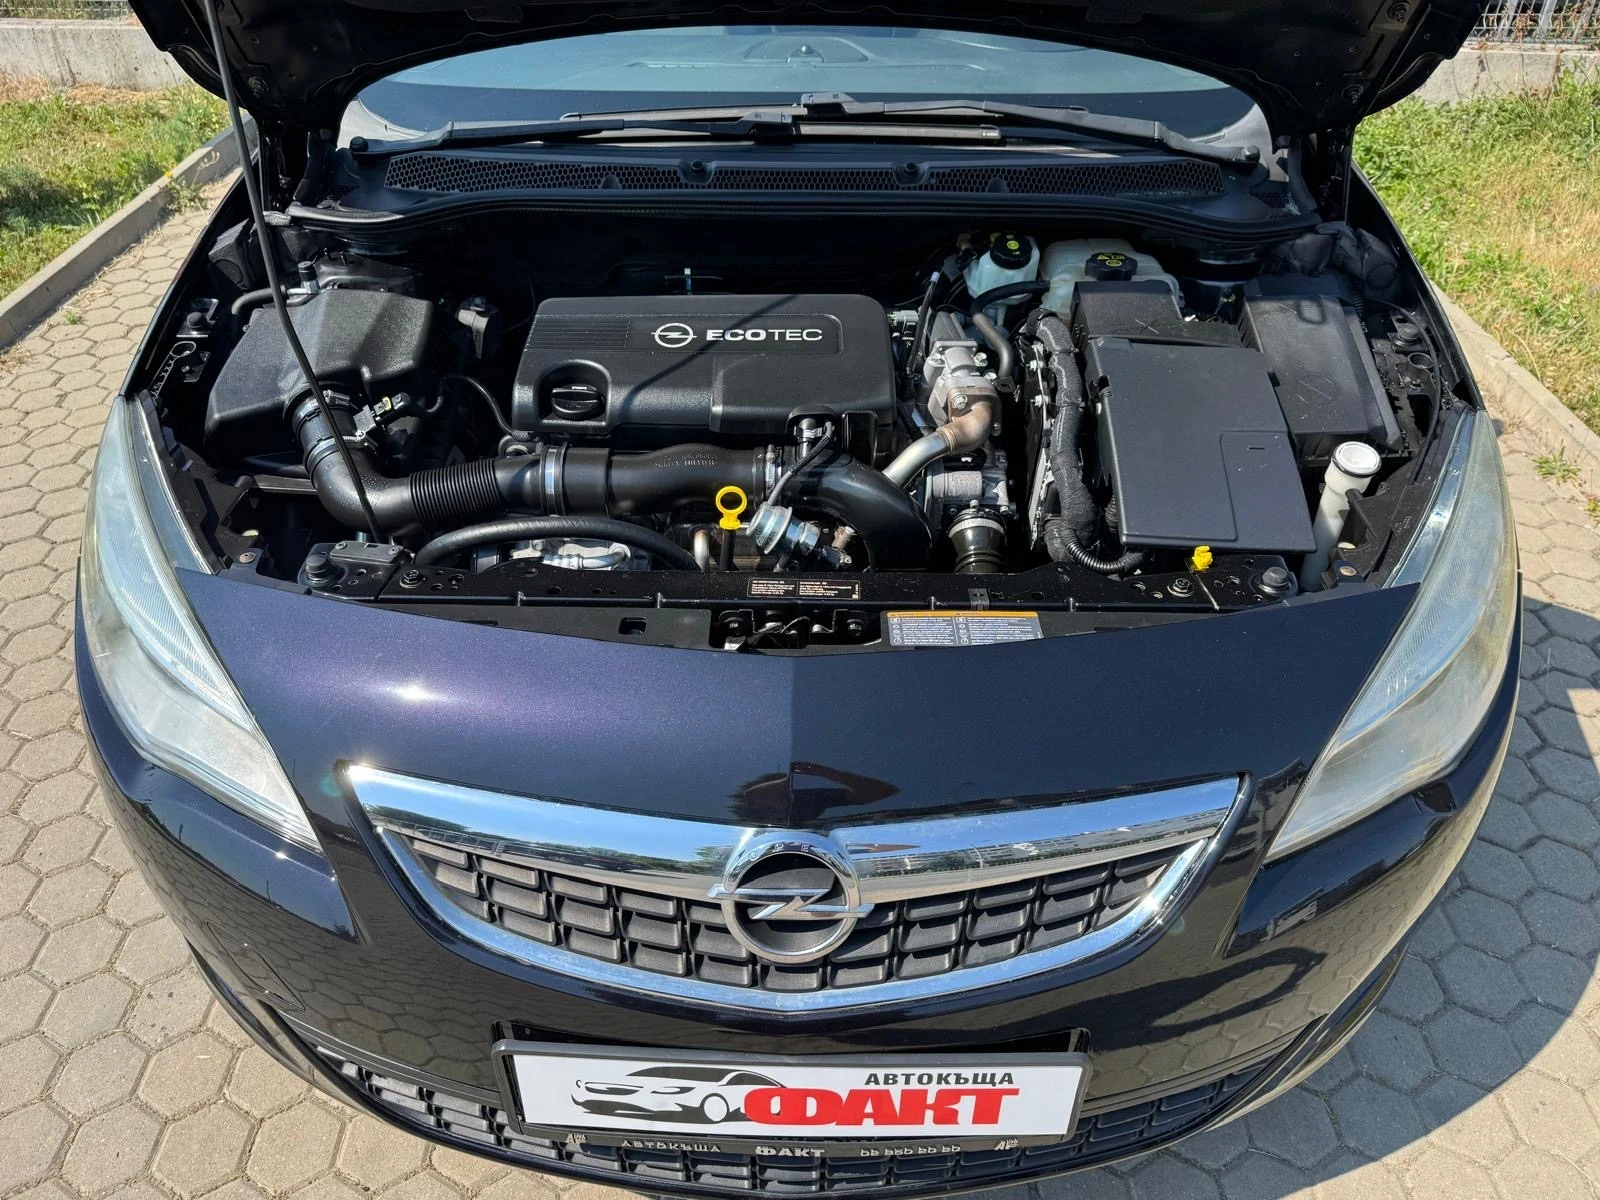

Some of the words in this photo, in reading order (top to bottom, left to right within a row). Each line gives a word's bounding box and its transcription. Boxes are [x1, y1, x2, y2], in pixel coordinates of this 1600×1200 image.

[706, 329, 823, 341] ECOTEC
[864, 1072, 1015, 1087] АВТОКЪЩА
[743, 1087, 1020, 1127] ФАКТ
[755, 1145, 826, 1158] ФАКТ
